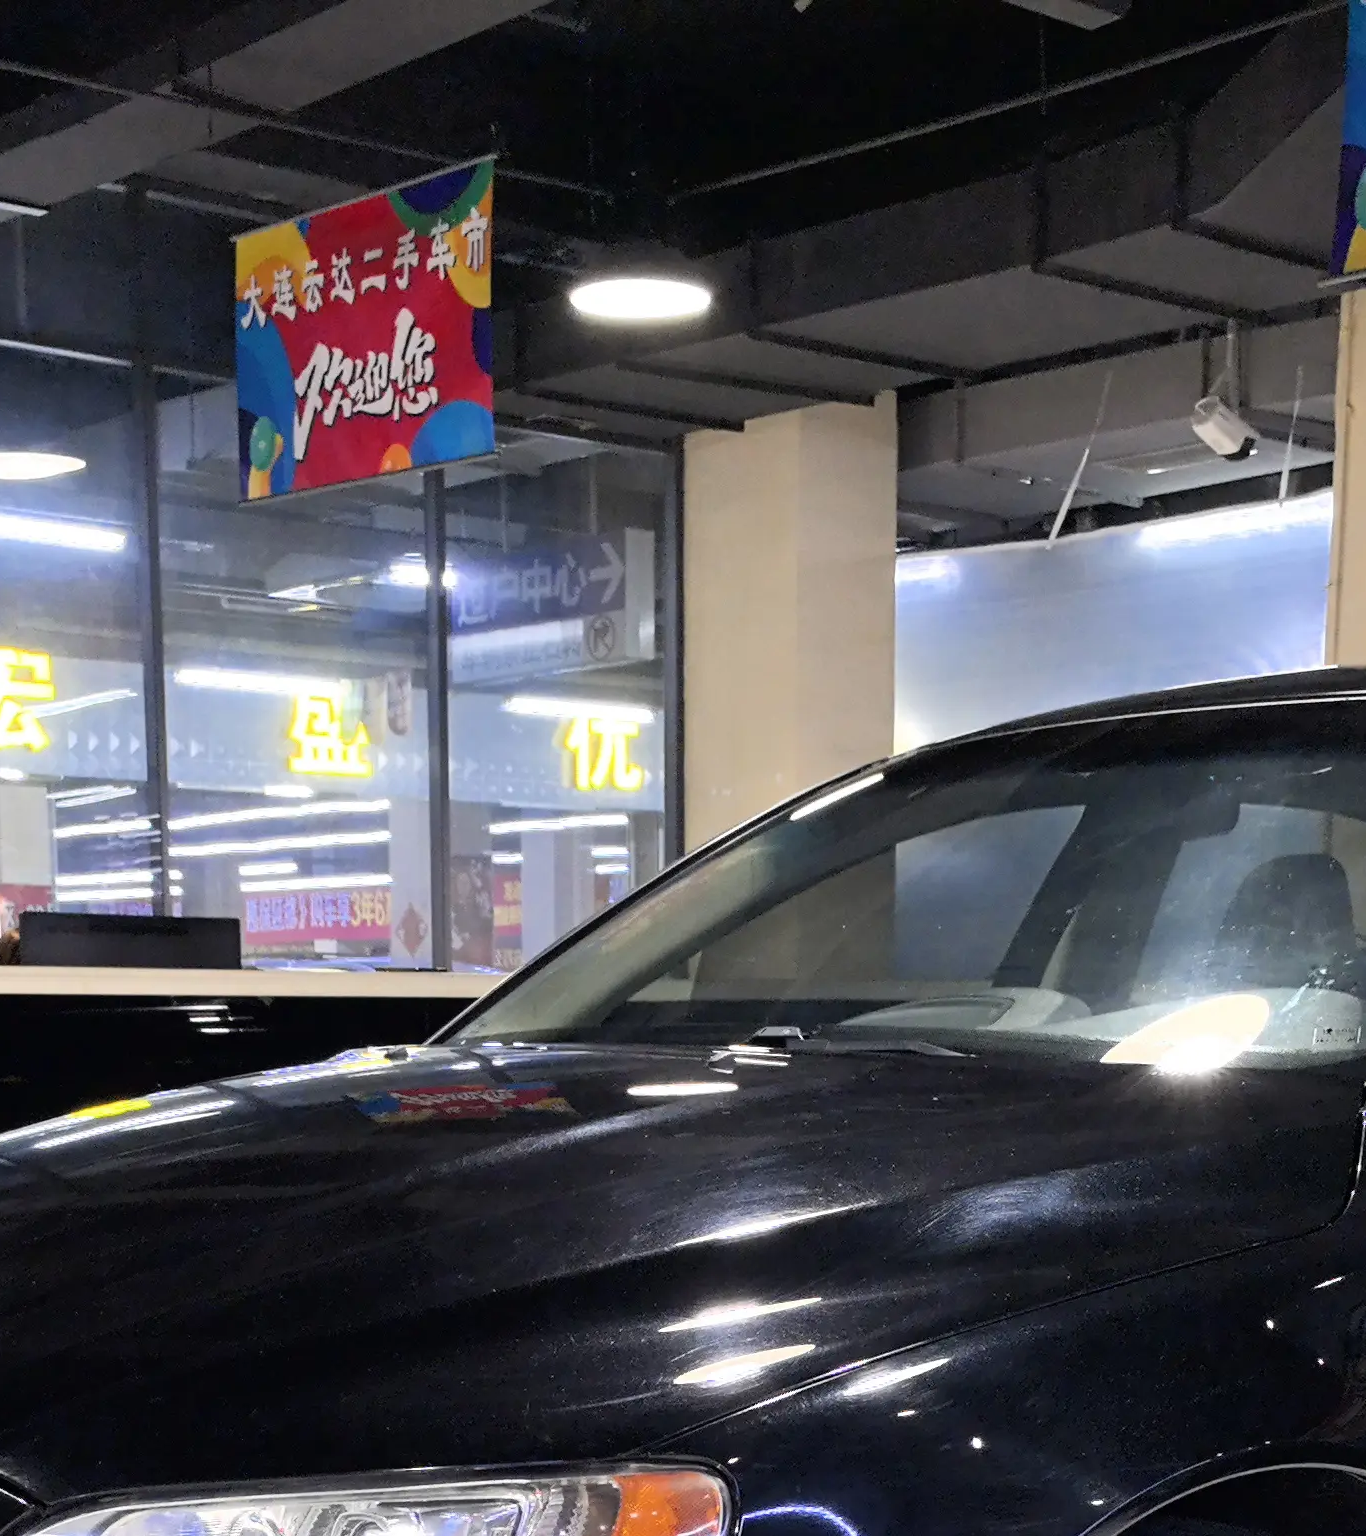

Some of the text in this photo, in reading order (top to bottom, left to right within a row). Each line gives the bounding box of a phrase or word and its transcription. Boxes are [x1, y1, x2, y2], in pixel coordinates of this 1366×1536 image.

[241, 207, 490, 330] 大连云达二手车市
[293, 307, 439, 462] 欢迎您
[457, 552, 587, 627] 过户中心
